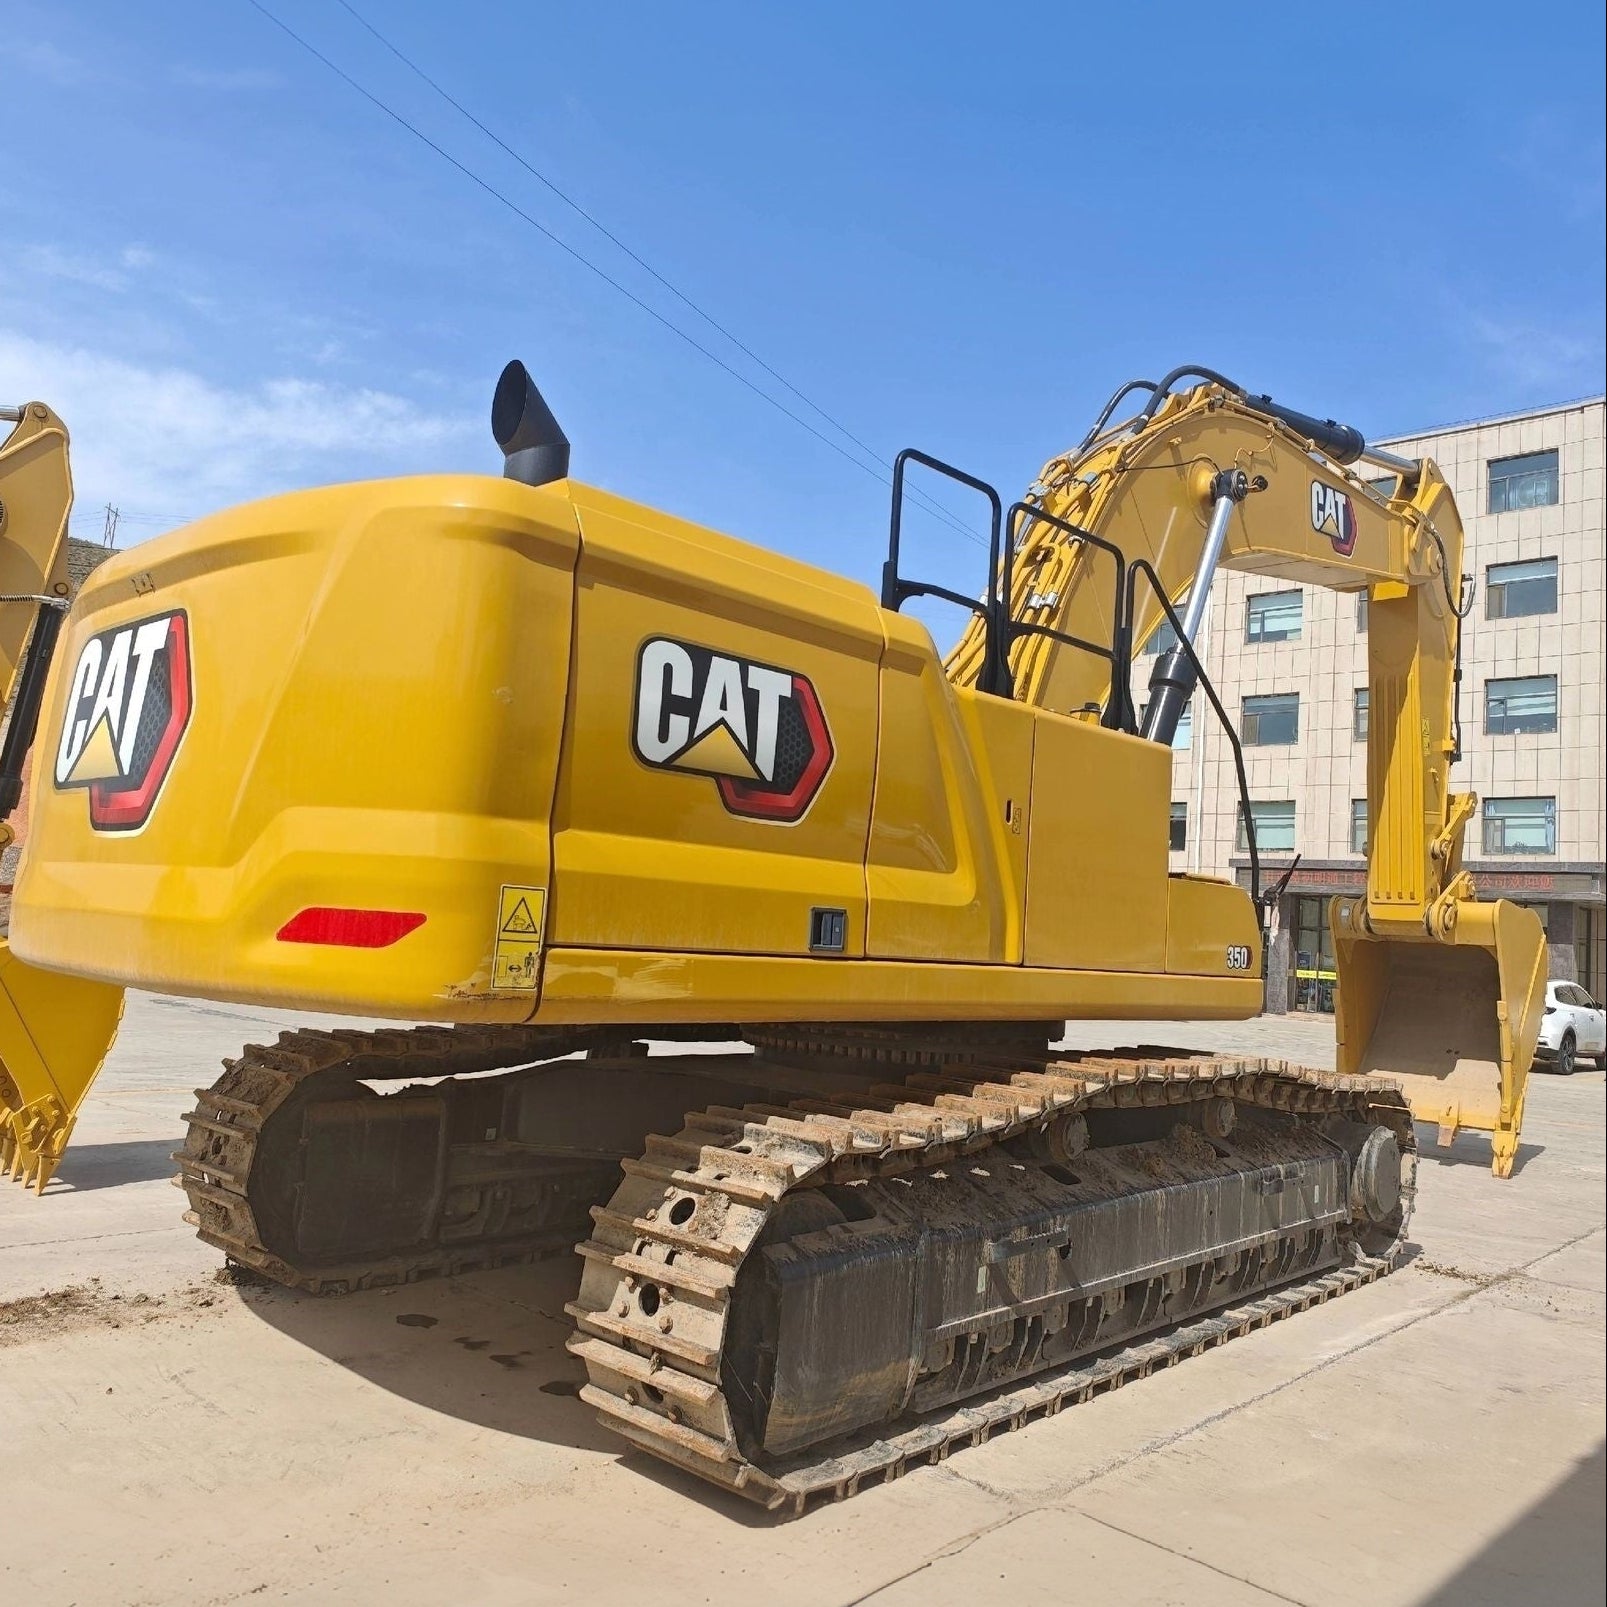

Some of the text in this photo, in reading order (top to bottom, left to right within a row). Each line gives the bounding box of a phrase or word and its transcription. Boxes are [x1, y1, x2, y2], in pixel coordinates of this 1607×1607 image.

[1311, 480, 1346, 540] CAT
[56, 616, 172, 783] CAT
[636, 640, 793, 782] CAT
[1227, 945, 1248, 969] 350
